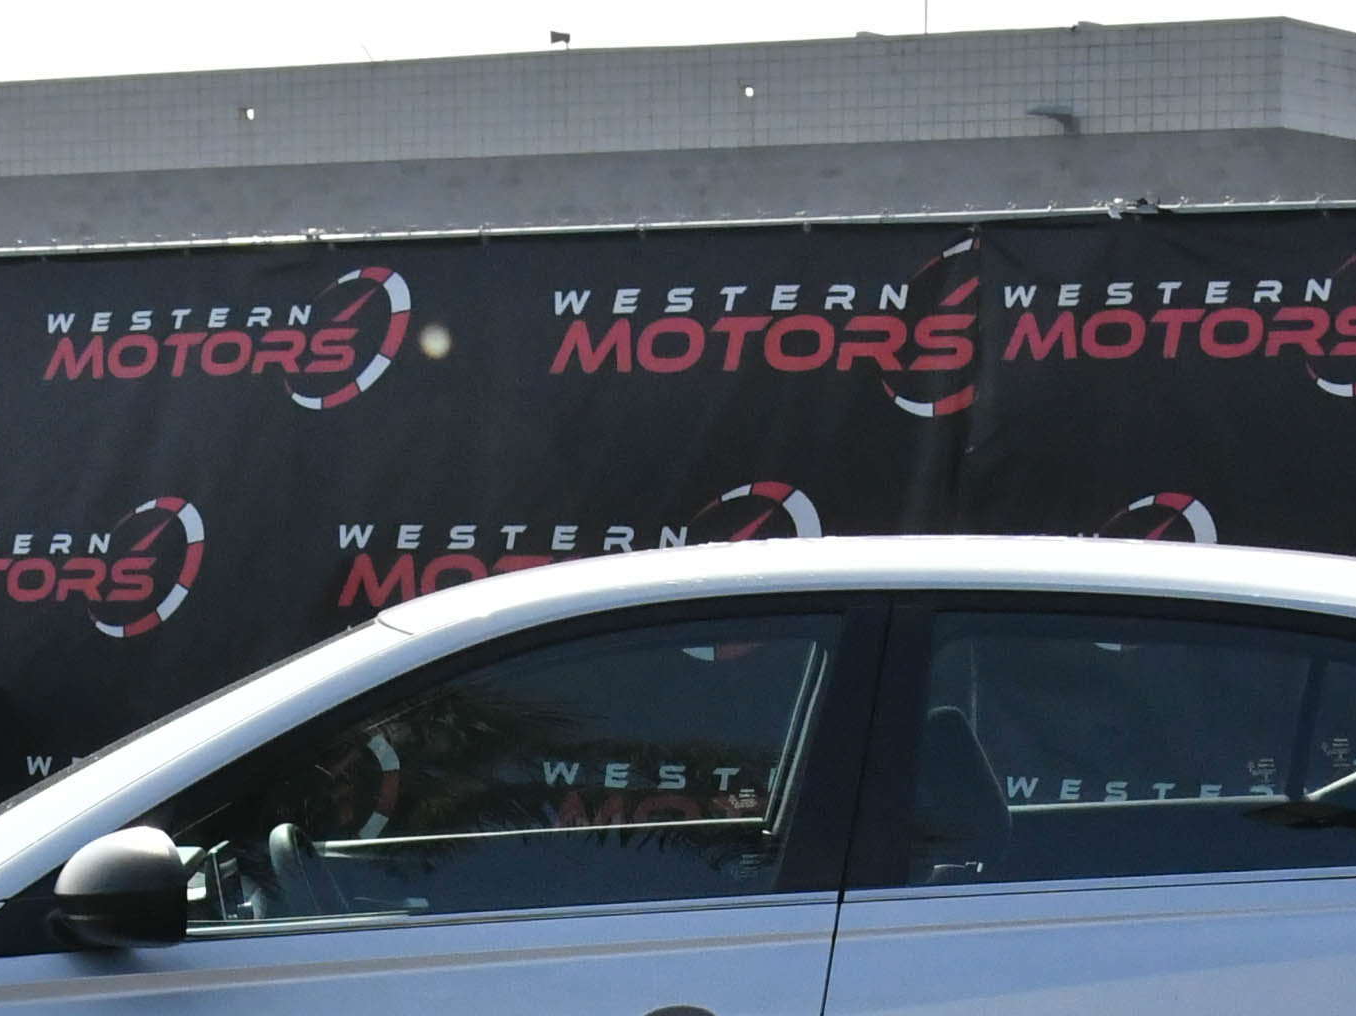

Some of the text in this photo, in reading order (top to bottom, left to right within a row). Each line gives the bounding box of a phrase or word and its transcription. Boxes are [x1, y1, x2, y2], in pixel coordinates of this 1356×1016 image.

[554, 283, 909, 316] WESTERN
[1004, 278, 1333, 308] WESTERN
[47, 304, 312, 334] WESTERN
[45, 330, 358, 380] MOTORS
[550, 313, 976, 374] MOTORS
[338, 524, 690, 551] WESTERN
